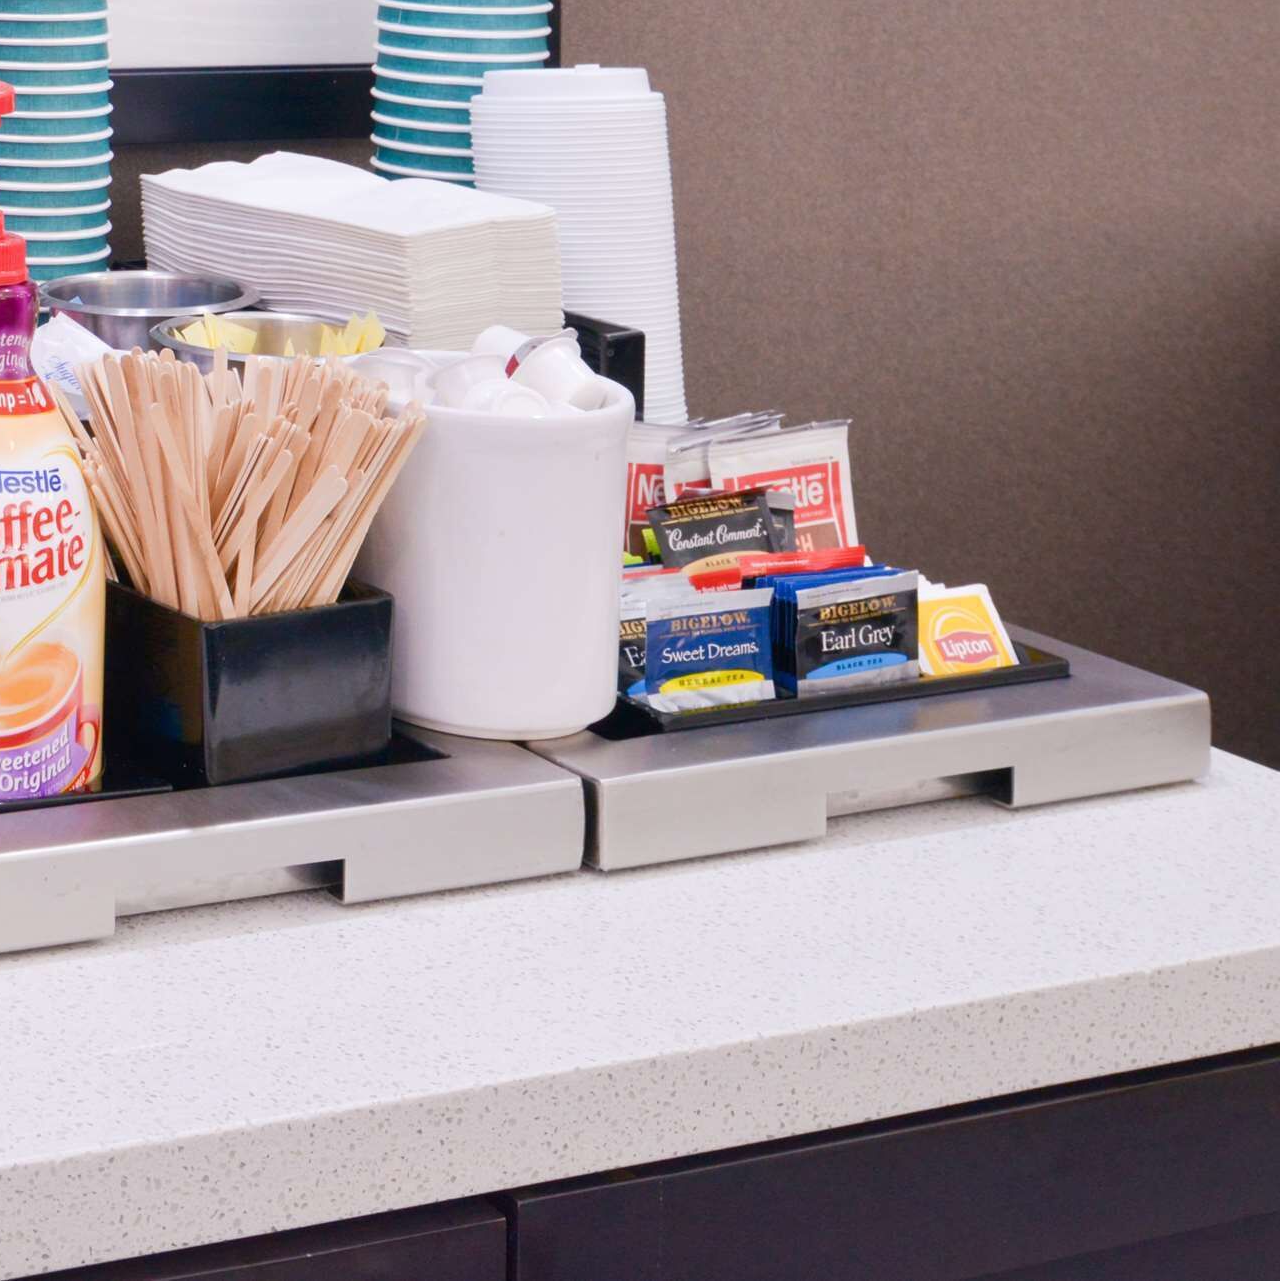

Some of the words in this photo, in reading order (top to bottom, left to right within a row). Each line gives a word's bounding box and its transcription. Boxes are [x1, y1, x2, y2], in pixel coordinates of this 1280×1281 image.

[821, 627, 856, 652] Earl
[859, 624, 895, 646] Grey
[661, 644, 706, 664] Sweet
[941, 638, 993, 660] Lipton
[867, 657, 883, 666] TEA
[727, 674, 745, 682] TEA
